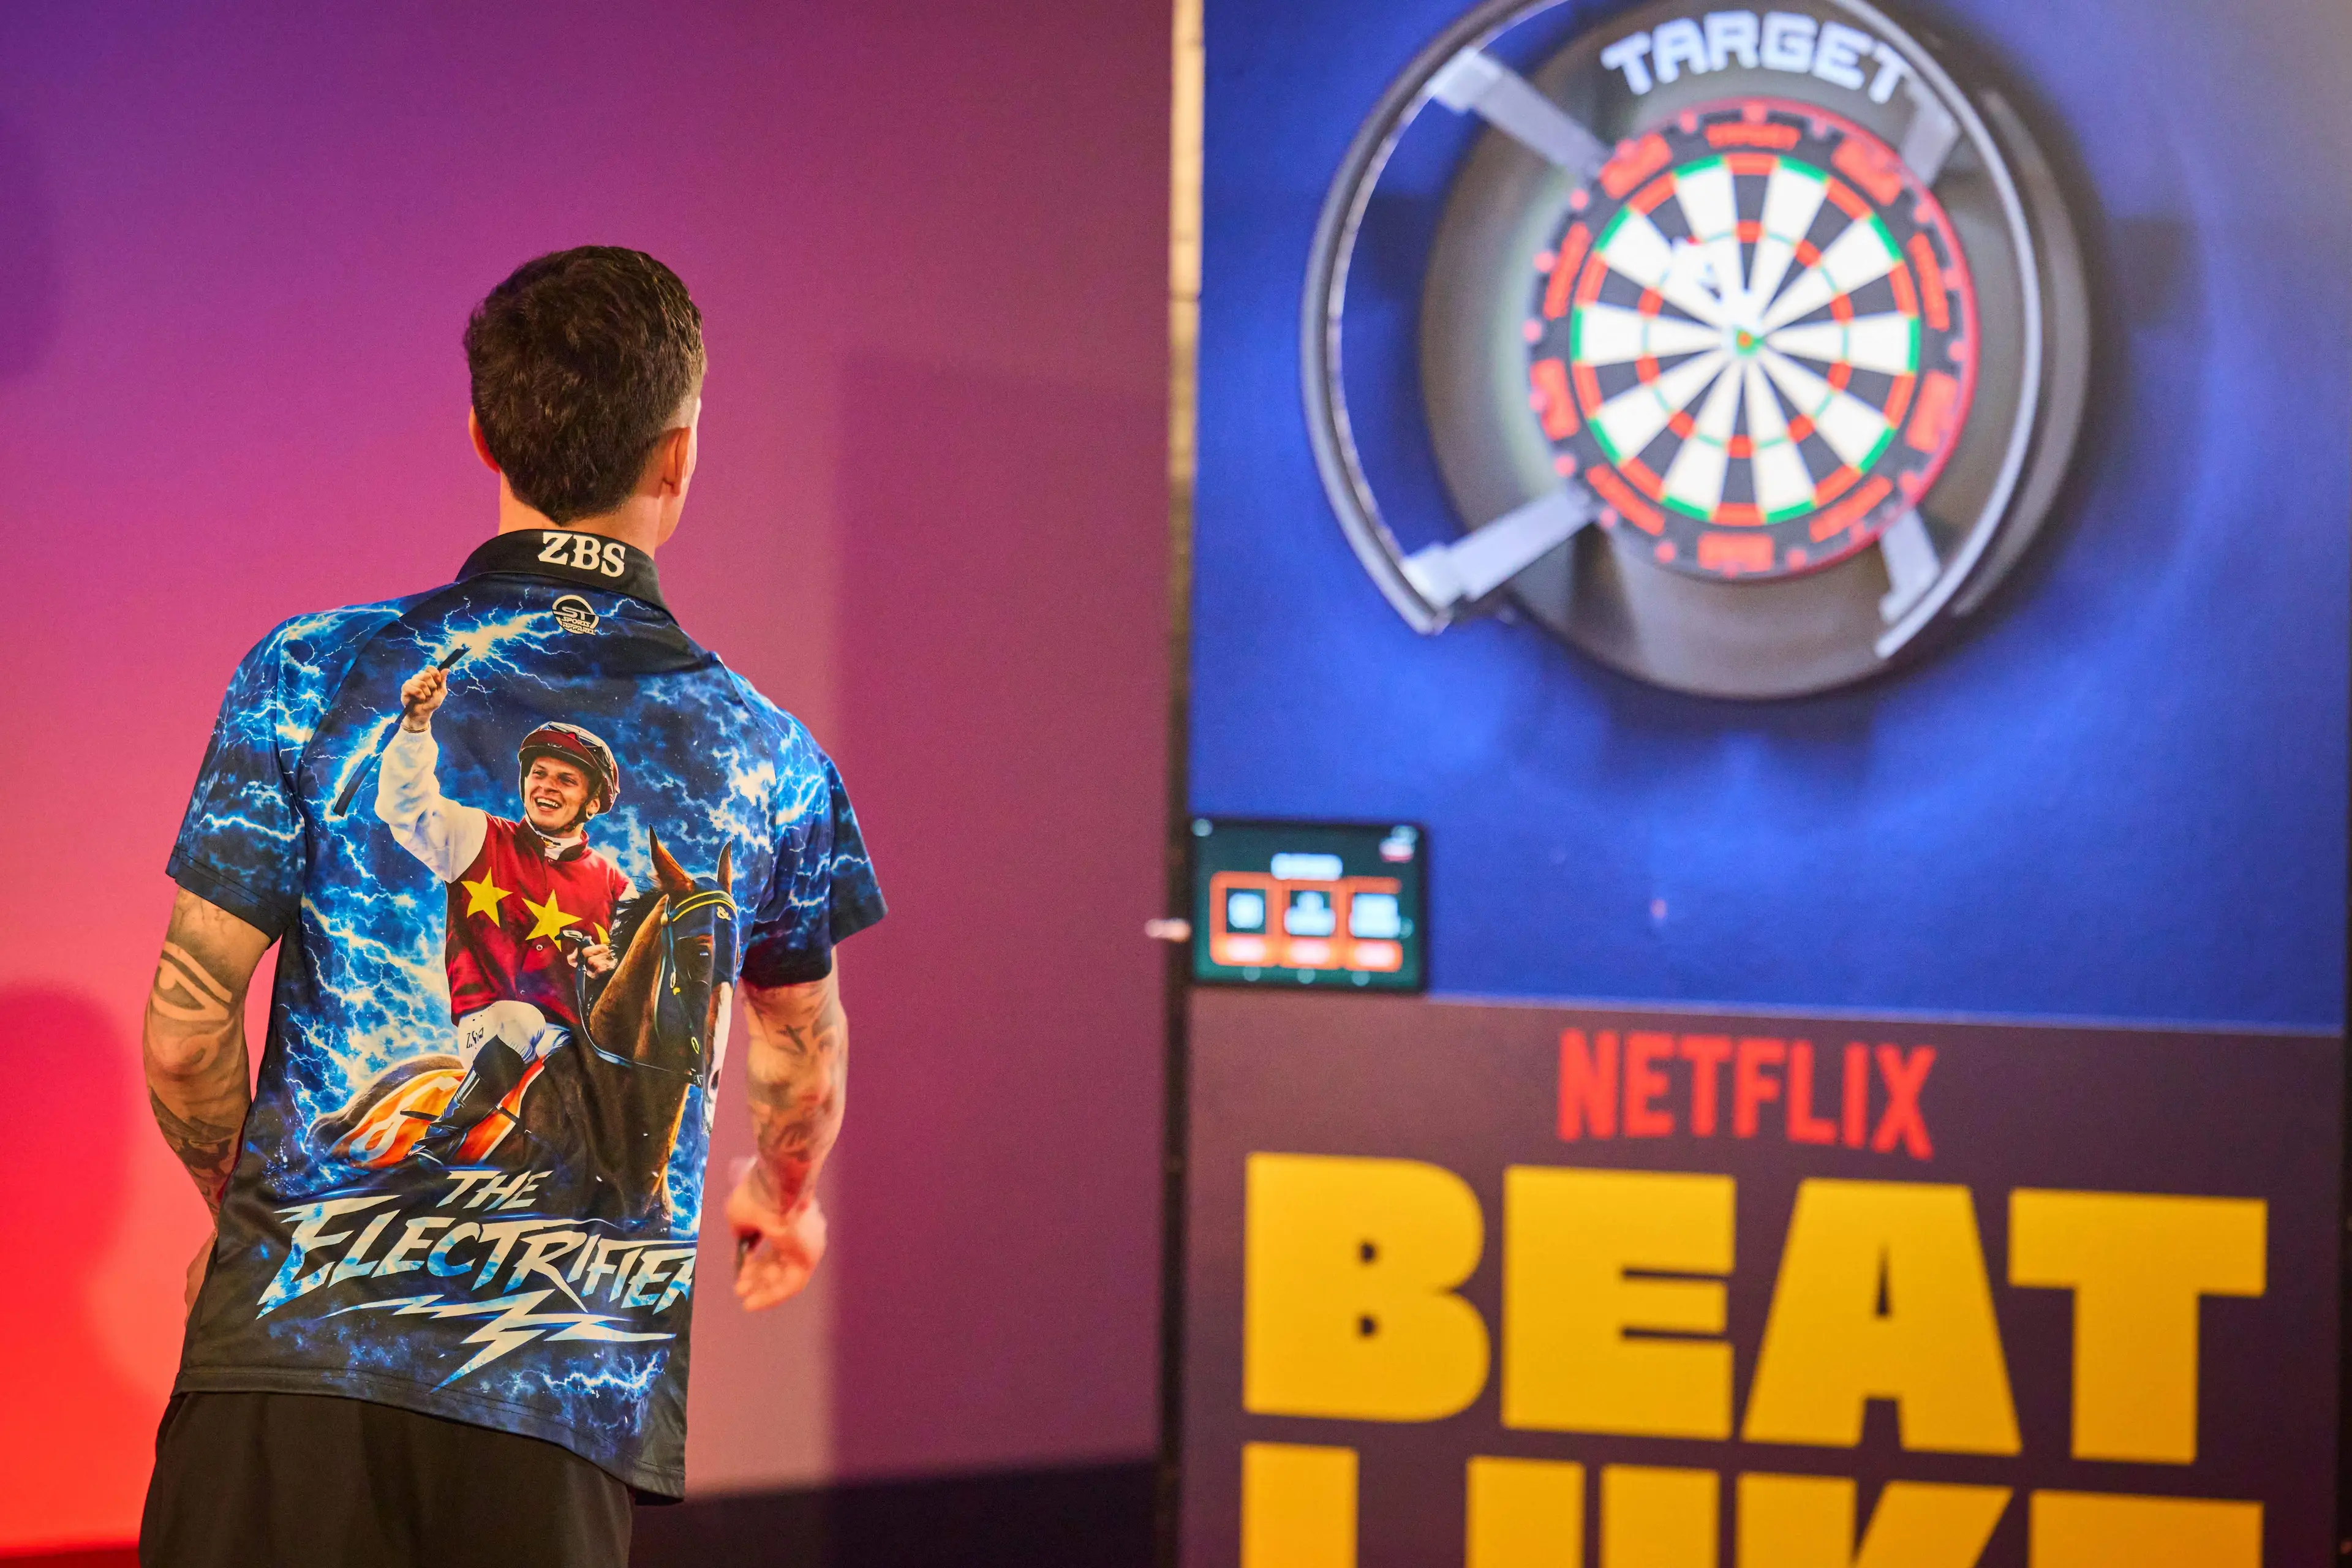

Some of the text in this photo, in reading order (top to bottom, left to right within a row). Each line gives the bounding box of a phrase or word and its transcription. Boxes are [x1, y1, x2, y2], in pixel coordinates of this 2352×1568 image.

[1600, 9, 1911, 105] TARGET
[537, 531, 626, 578] ZBS
[561, 616, 591, 628] SPORTS
[562, 621, 597, 636] APPAREL
[1556, 1027, 1937, 1160] NETFLIX
[435, 1170, 554, 1212] THE
[1242, 1152, 2267, 1463] BEAT
